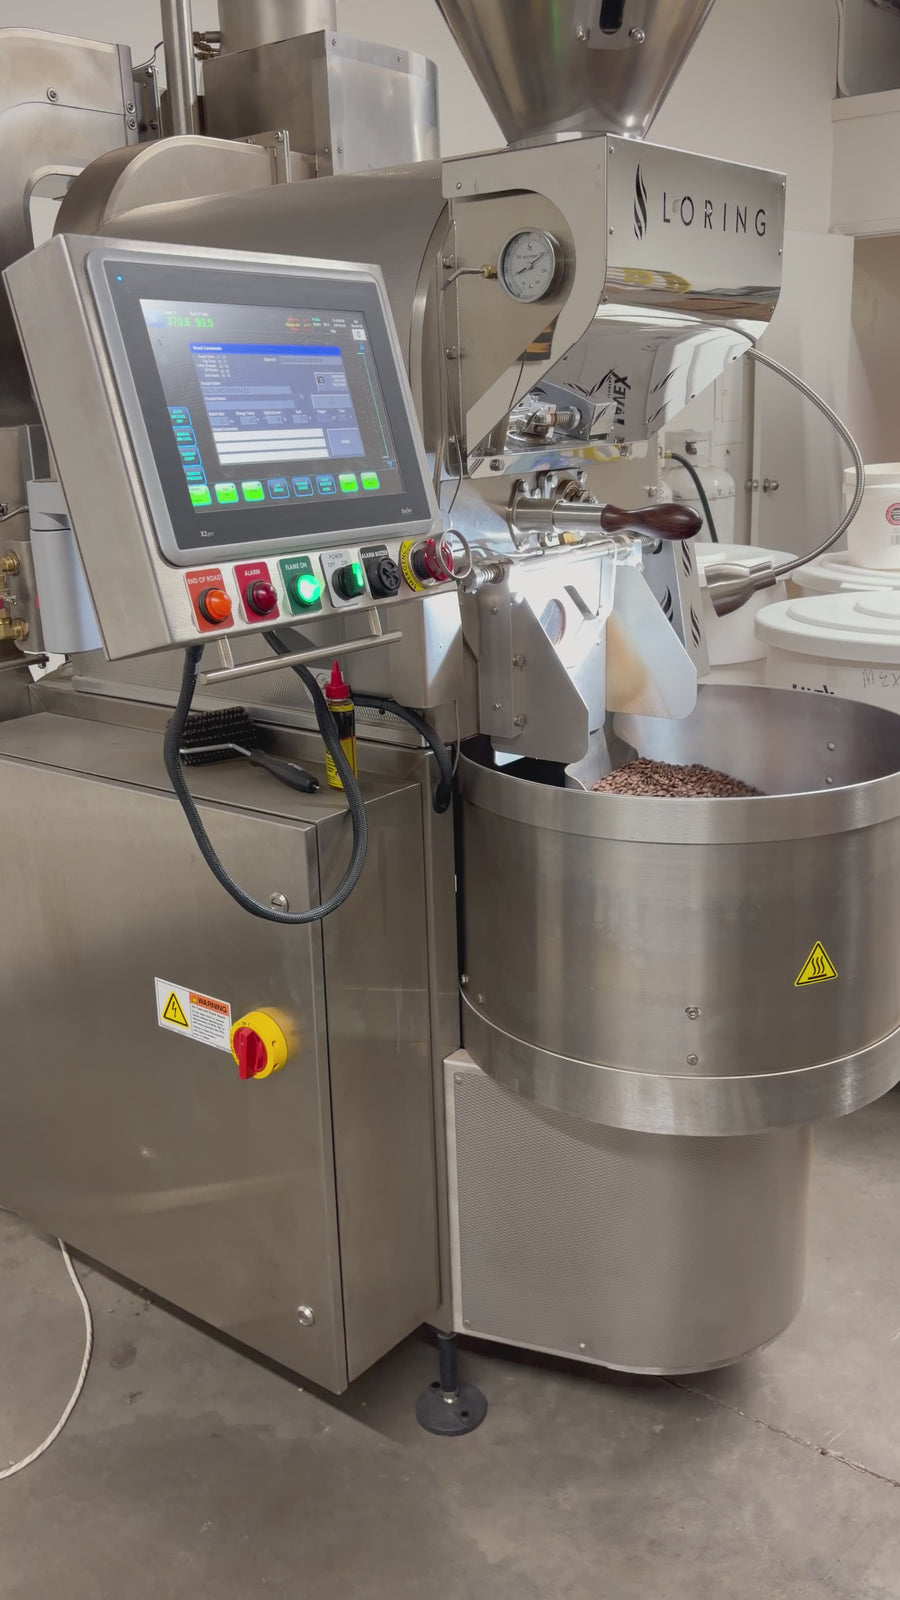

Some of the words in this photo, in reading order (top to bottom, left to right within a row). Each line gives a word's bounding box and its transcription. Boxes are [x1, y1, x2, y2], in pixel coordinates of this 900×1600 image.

[662, 191, 767, 238] LORING
[328, 552, 343, 560] POWER
[284, 563, 299, 571] FLAME
[244, 568, 261, 577] ALARM
[187, 577, 198, 585] END
[198, 576, 206, 584] OF
[206, 574, 223, 582] ROAST
[197, 996, 228, 1014] WARNING
